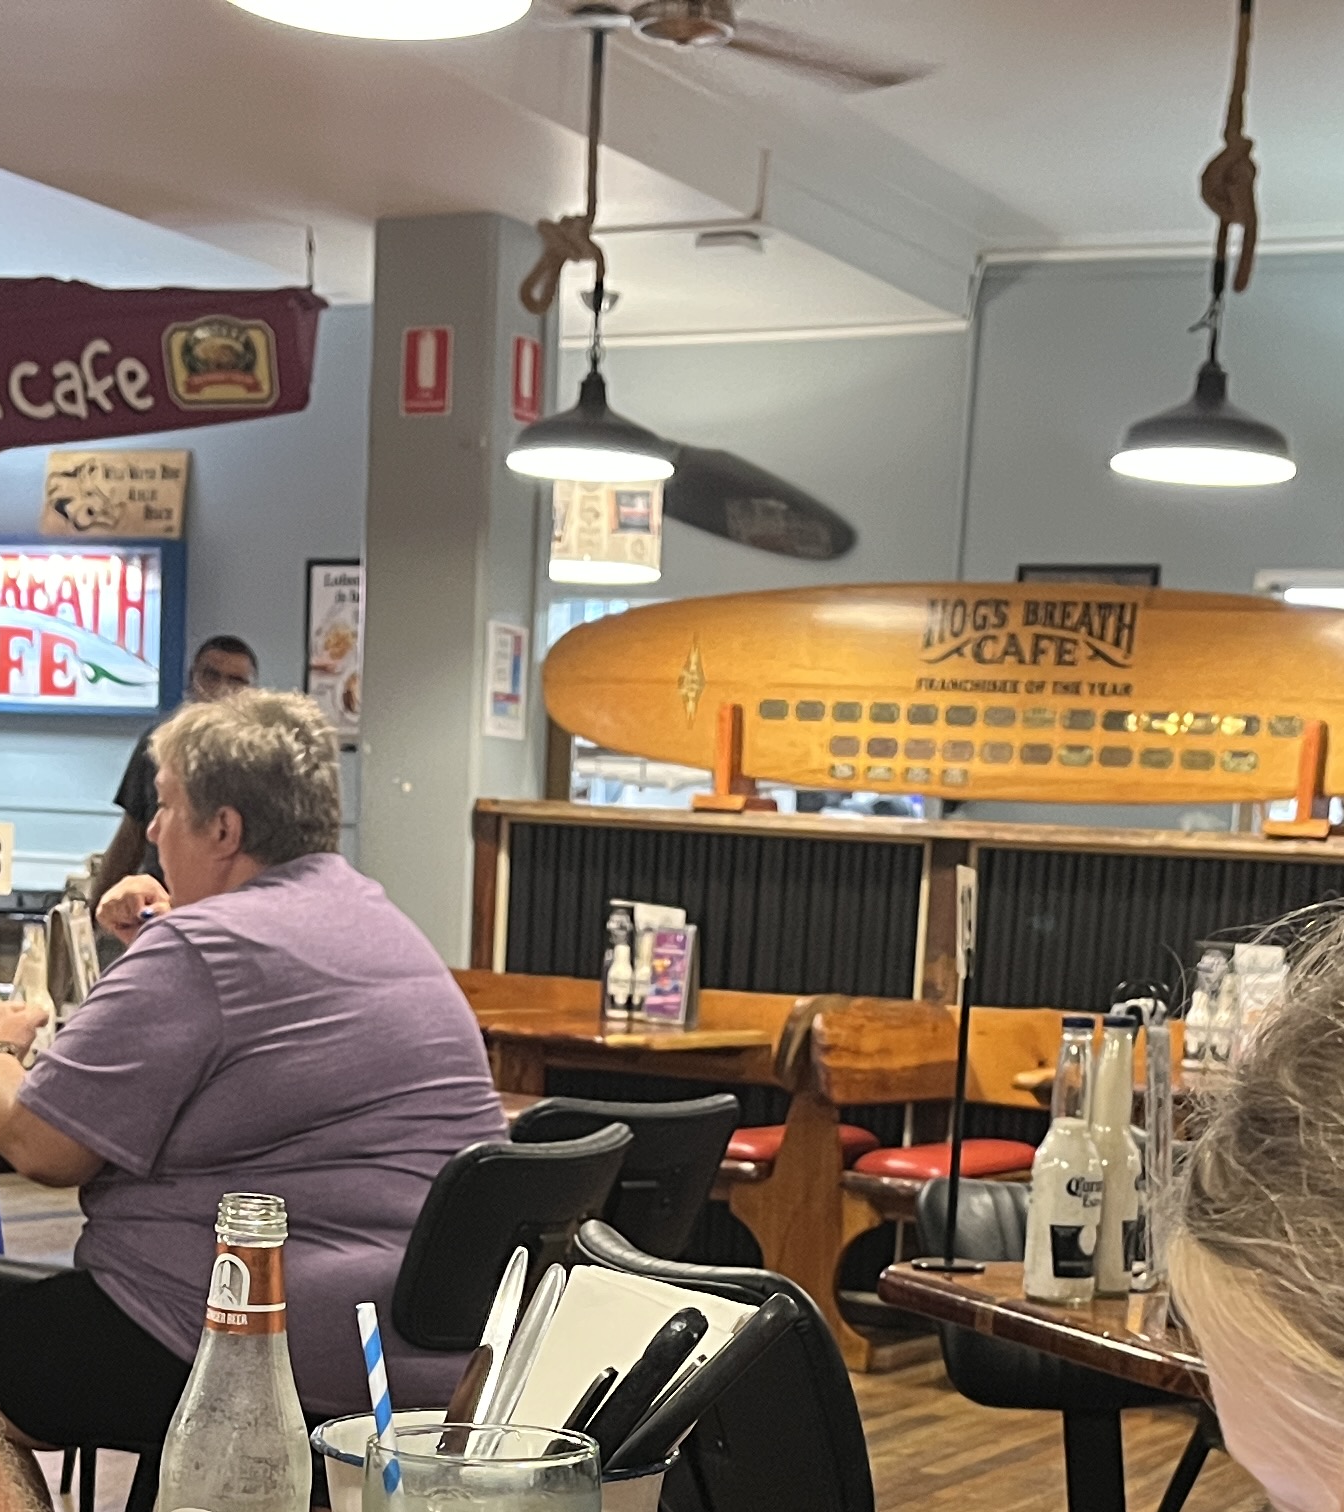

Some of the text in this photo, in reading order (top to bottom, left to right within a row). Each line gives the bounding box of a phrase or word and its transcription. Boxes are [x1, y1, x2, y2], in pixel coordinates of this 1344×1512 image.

[1023, 600, 1138, 655] BREATH
[971, 633, 1079, 666] CAFE
[1088, 682, 1133, 697] YEAR
